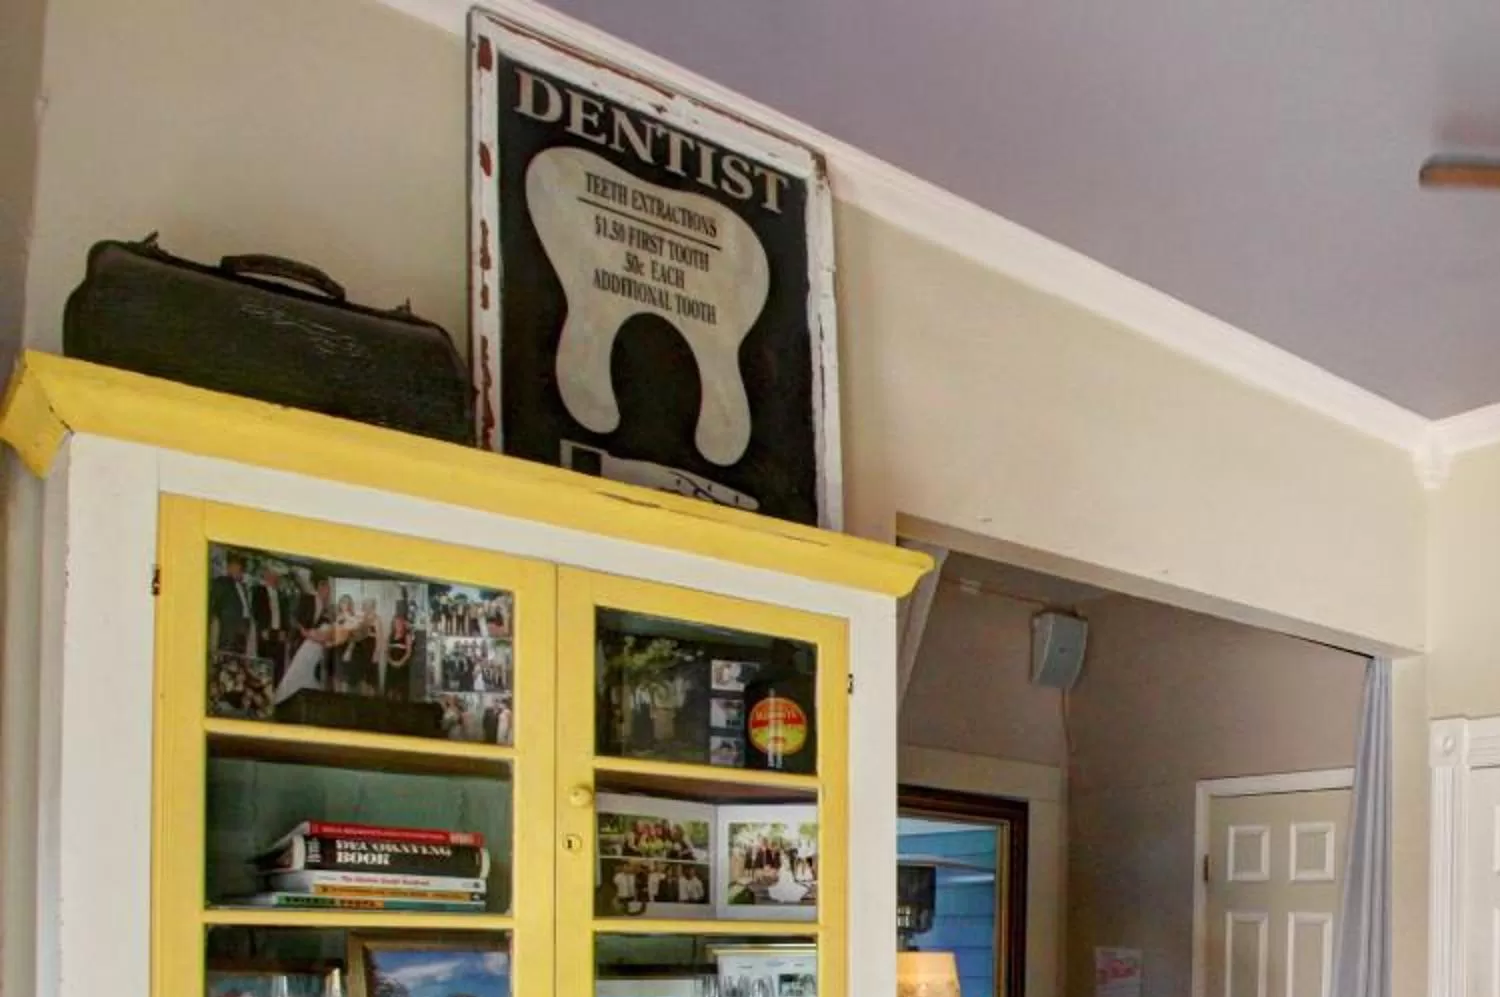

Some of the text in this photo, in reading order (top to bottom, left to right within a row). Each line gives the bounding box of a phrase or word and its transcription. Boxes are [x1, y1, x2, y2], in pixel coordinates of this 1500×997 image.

[513, 67, 790, 214] DENTIST
[585, 171, 718, 239] TEETH EXTRACTIONS
[627, 224, 665, 257] FIRST
[667, 239, 710, 273] TOOTH
[650, 259, 685, 290] EACH
[592, 267, 717, 325] ADDITIONAL TOOTH
[335, 850, 391, 866] BOOK
